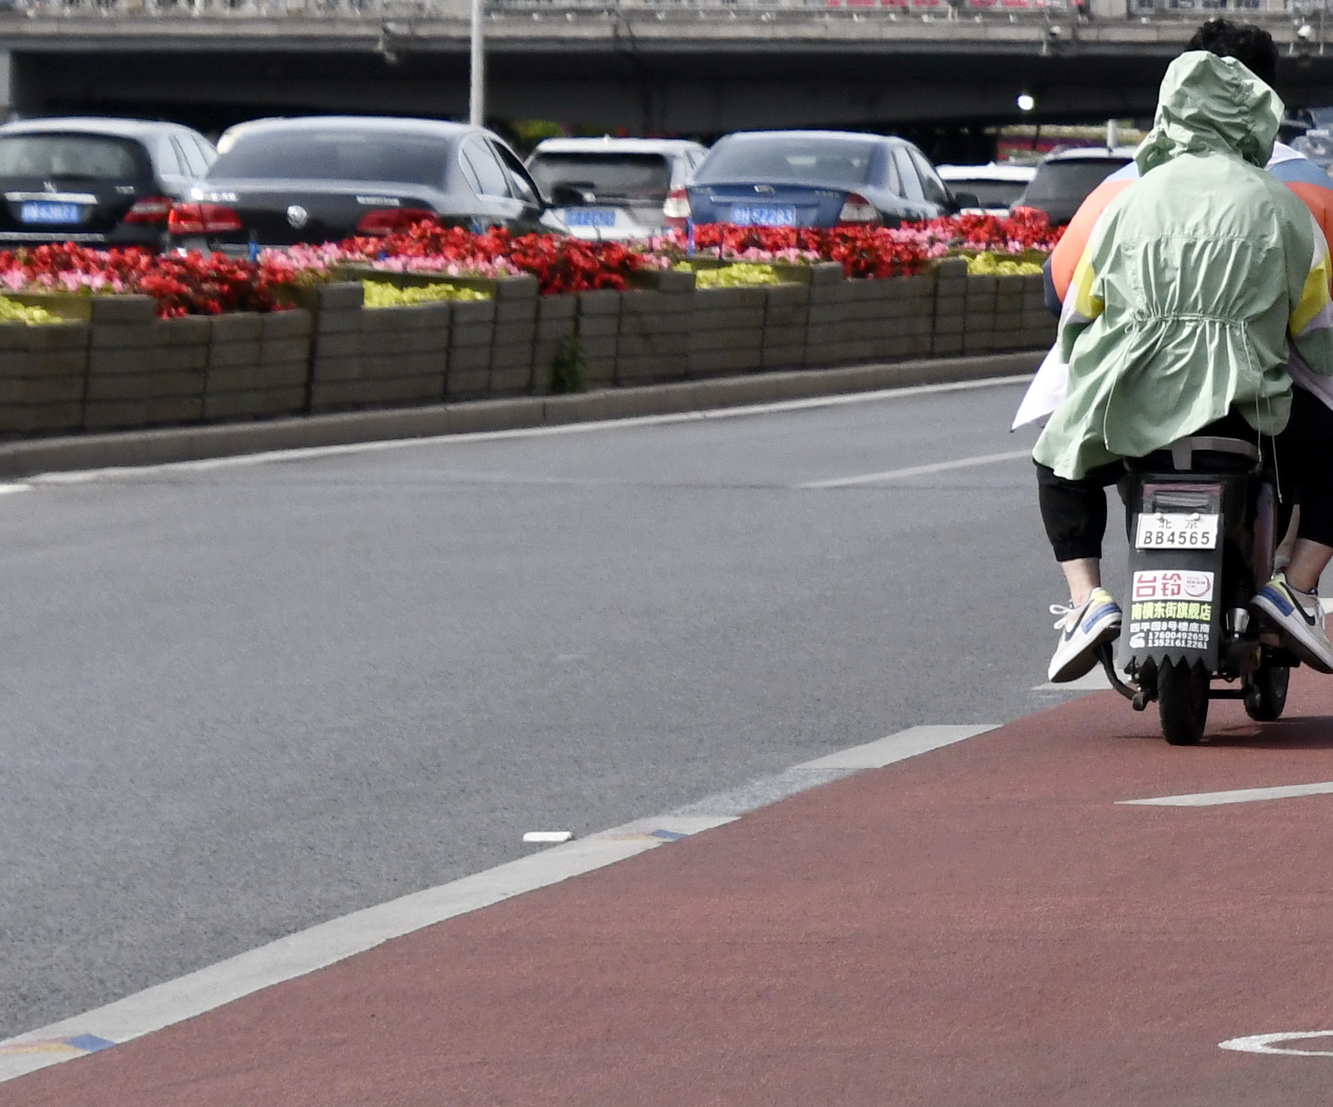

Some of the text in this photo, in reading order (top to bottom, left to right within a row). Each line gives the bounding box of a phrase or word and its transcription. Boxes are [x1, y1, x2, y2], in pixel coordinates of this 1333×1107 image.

[1158, 516, 1199, 529] 北京
[1143, 531, 1211, 545] BB4565
[1136, 573, 1182, 598] 台铃
[1131, 601, 1212, 622] 南横东街旗舰店
[1148, 632, 1210, 641] 17600492655
[1147, 639, 1208, 649] 13521612261
